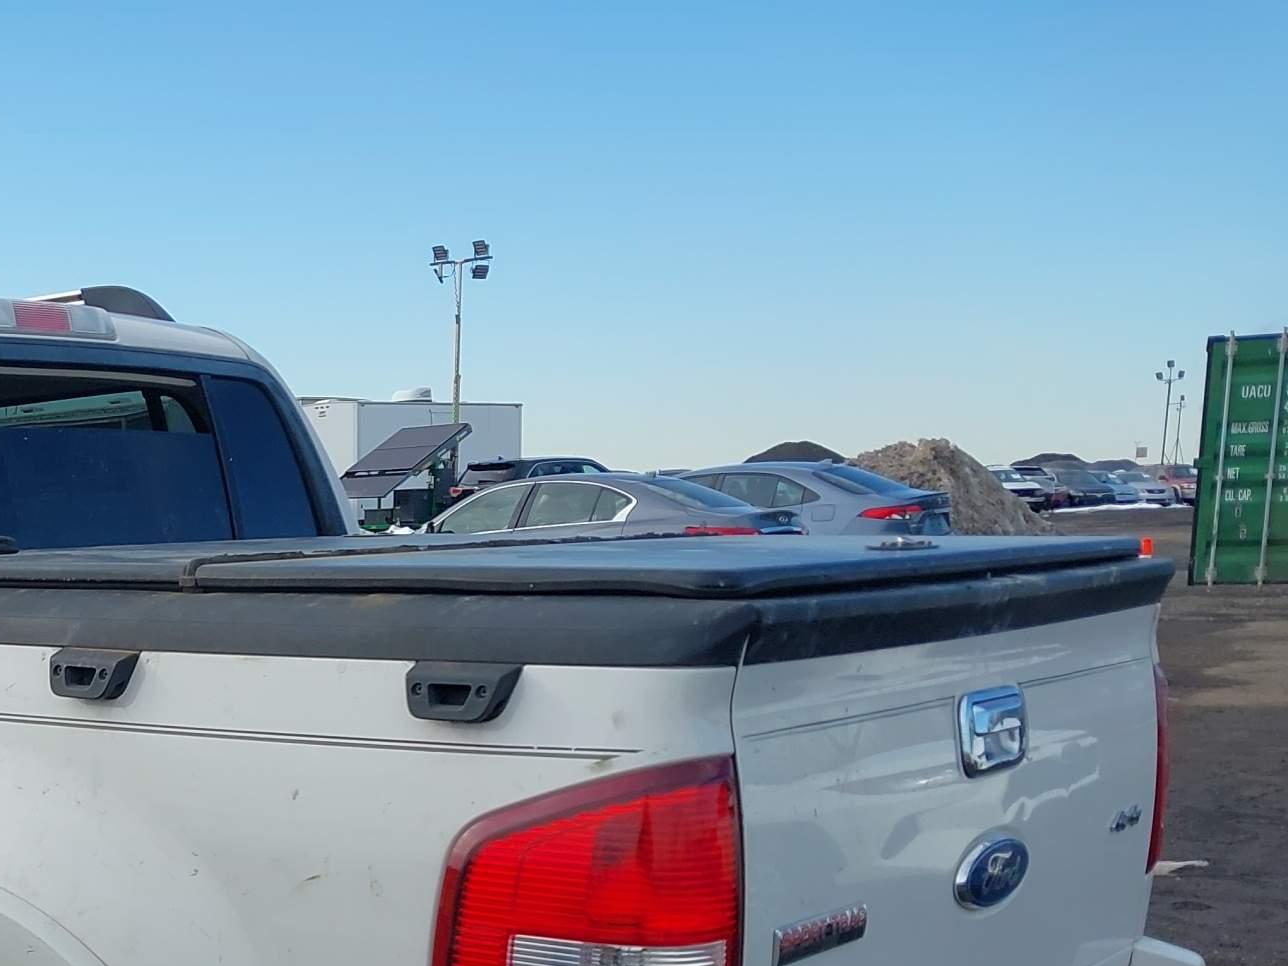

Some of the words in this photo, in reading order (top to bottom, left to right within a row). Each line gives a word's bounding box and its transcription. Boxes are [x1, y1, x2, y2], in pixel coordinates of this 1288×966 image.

[1241, 384, 1271, 398] UACU
[1230, 444, 1247, 456] TARE
[1227, 467, 1240, 480] NET
